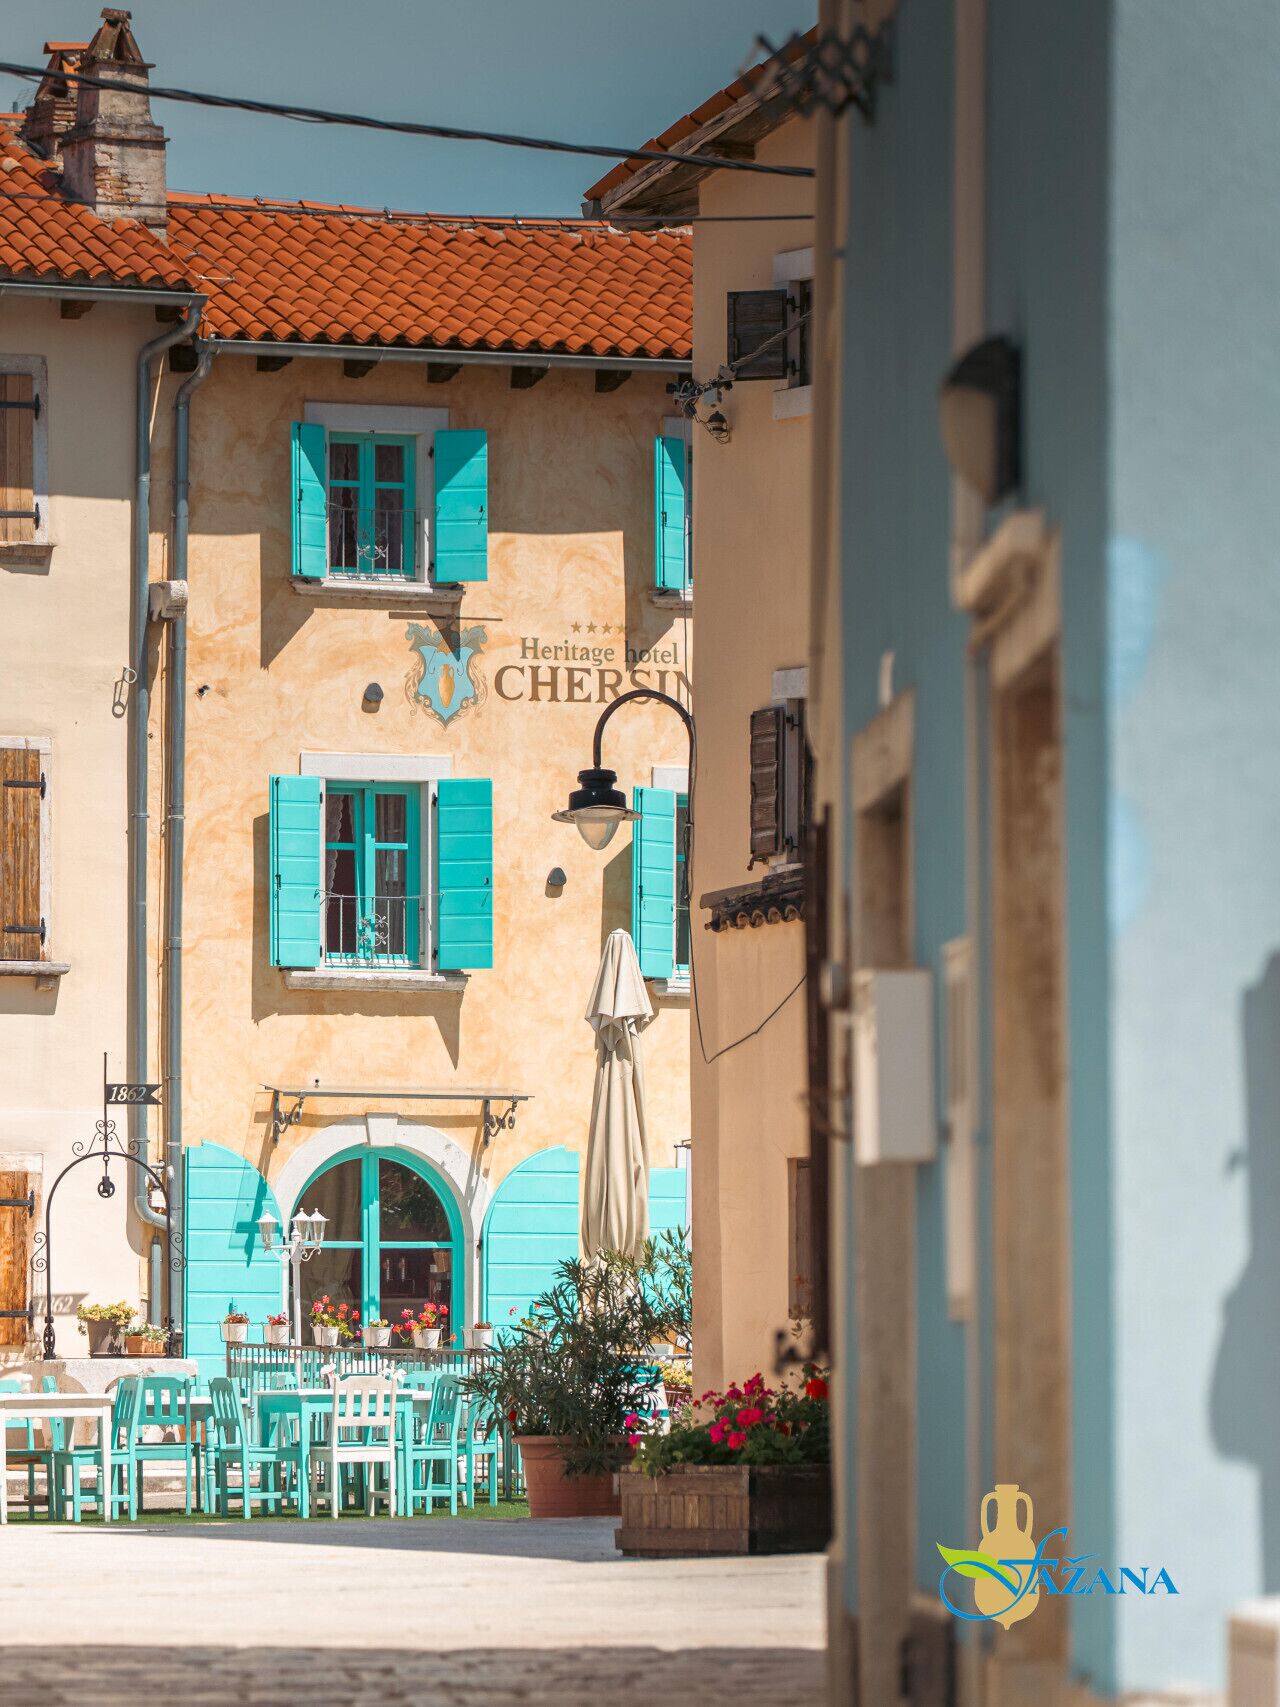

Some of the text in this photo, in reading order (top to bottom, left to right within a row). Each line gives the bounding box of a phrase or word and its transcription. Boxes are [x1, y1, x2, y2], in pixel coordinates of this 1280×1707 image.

[520, 636, 677, 667] Heritage hotel
[108, 1085, 147, 1102] 1862
